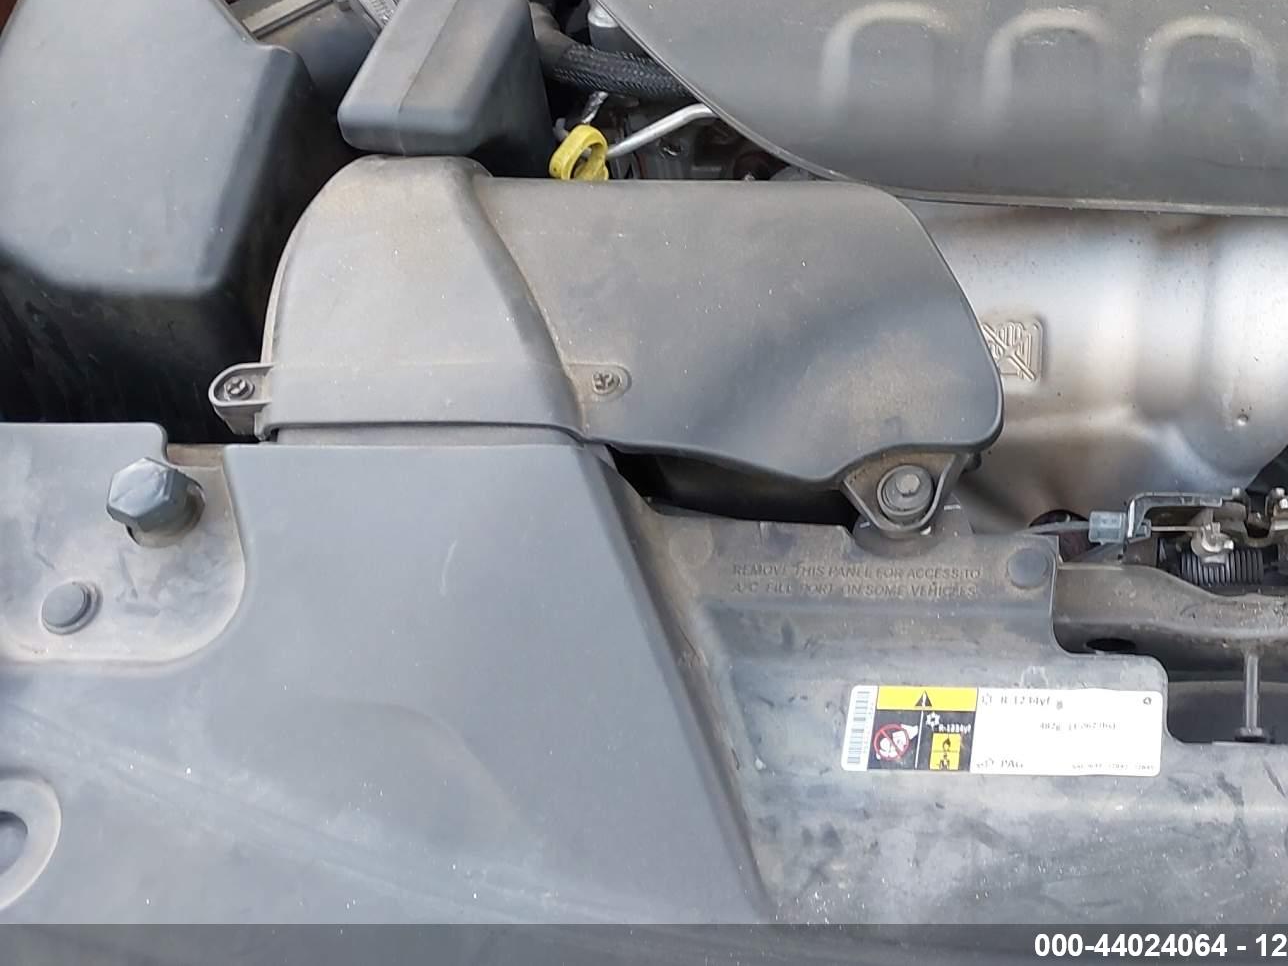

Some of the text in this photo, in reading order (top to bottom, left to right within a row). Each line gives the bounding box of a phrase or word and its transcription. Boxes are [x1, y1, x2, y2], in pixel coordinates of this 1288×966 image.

[795, 564, 825, 578] THIS
[828, 565, 871, 579] PANEL
[876, 566, 903, 580] FOR
[907, 566, 959, 580] ACCESS
[963, 567, 981, 580] TO
